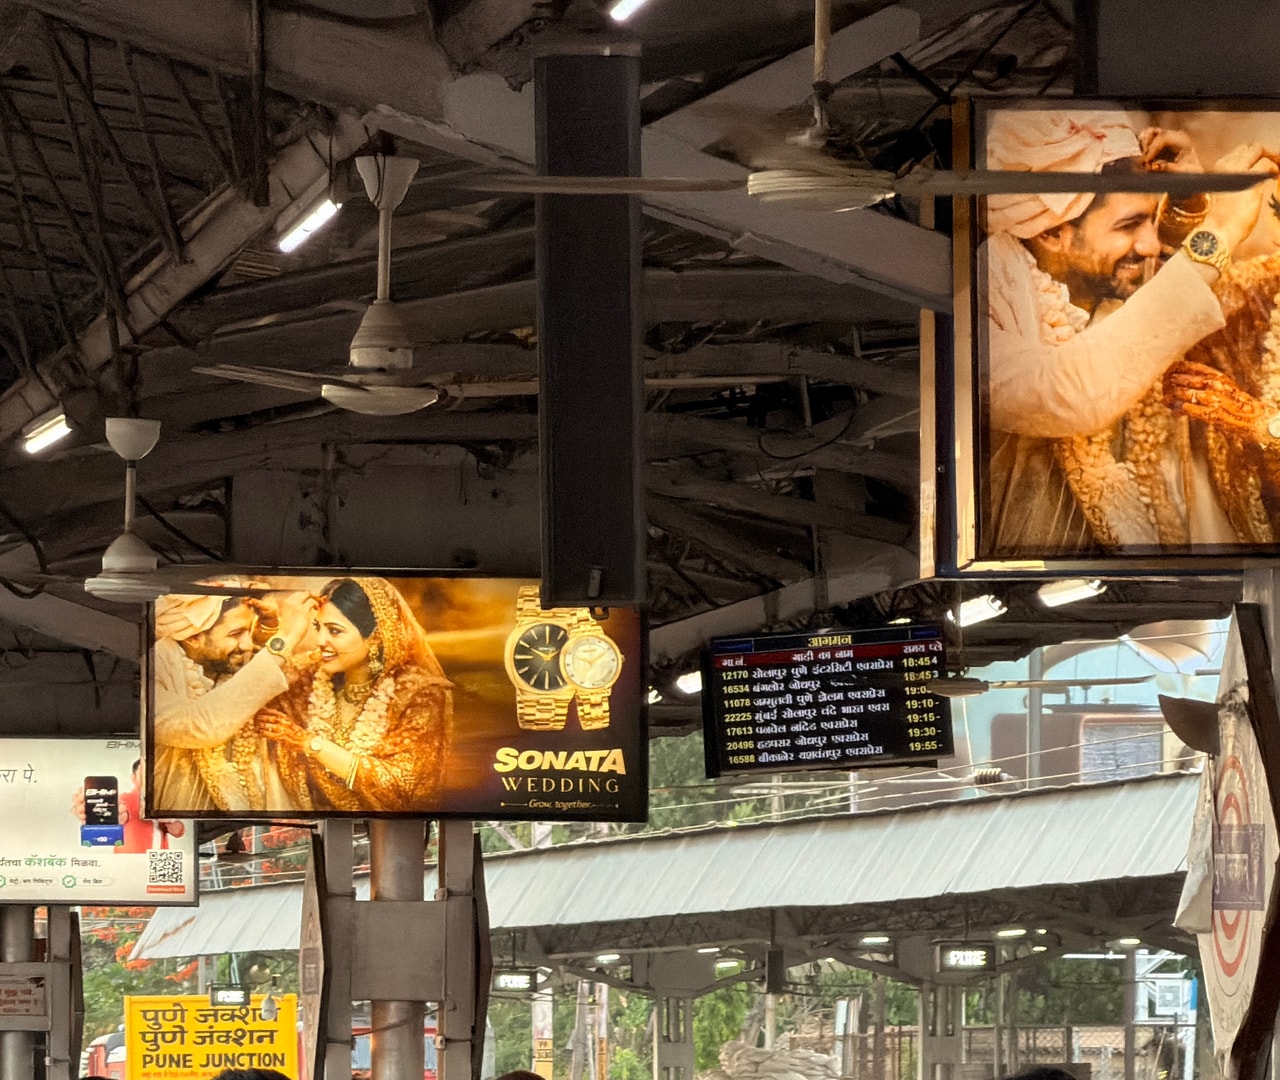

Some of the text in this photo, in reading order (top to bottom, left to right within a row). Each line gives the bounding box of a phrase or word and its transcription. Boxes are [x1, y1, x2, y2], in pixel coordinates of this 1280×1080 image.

[807, 634, 853, 648] आगमन
[818, 651, 831, 660] का
[835, 650, 854, 659] नाम
[903, 644, 926, 654] समय
[721, 670, 749, 681] 12170
[752, 668, 787, 679] सोलापुर
[790, 665, 808, 678] पुणे
[812, 660, 853, 676] इंटरसिटी
[902, 656, 931, 668] 18:45
[931, 656, 938, 665] 4
[722, 684, 750, 694] 16534
[788, 679, 822, 691] जोधपुर
[932, 670, 939, 678] 3
[724, 699, 751, 708] 11078
[796, 692, 813, 706] पुणे
[904, 686, 932, 696] 19:0
[724, 712, 752, 723] 22225
[754, 708, 778, 723] मुंबई
[781, 707, 817, 720] सोलापुर
[821, 704, 837, 716] वंदे
[841, 704, 864, 714] भारत
[905, 698, 934, 709] 19:10
[726, 726, 753, 736] 17613
[755, 722, 787, 735] पनवेल
[906, 712, 935, 723] 19:15
[726, 740, 754, 751] 20496
[795, 735, 827, 747] जोधपुर
[907, 726, 936, 737] 19:30
[493, 747, 627, 775] SONATA
[728, 754, 755, 765] 16588
[758, 750, 795, 763] बीकानेर
[909, 740, 938, 751] 19:55
[23, 763, 37, 783] पे.
[501, 777, 619, 793] WEDDING
[24, 853, 67, 867] कॅशबॅक
[140, 1002, 189, 1030] पुणे
[139, 1024, 279, 1052] पुणे जंक्शन
[142, 1052, 286, 1069] PUNE JUNCTION
